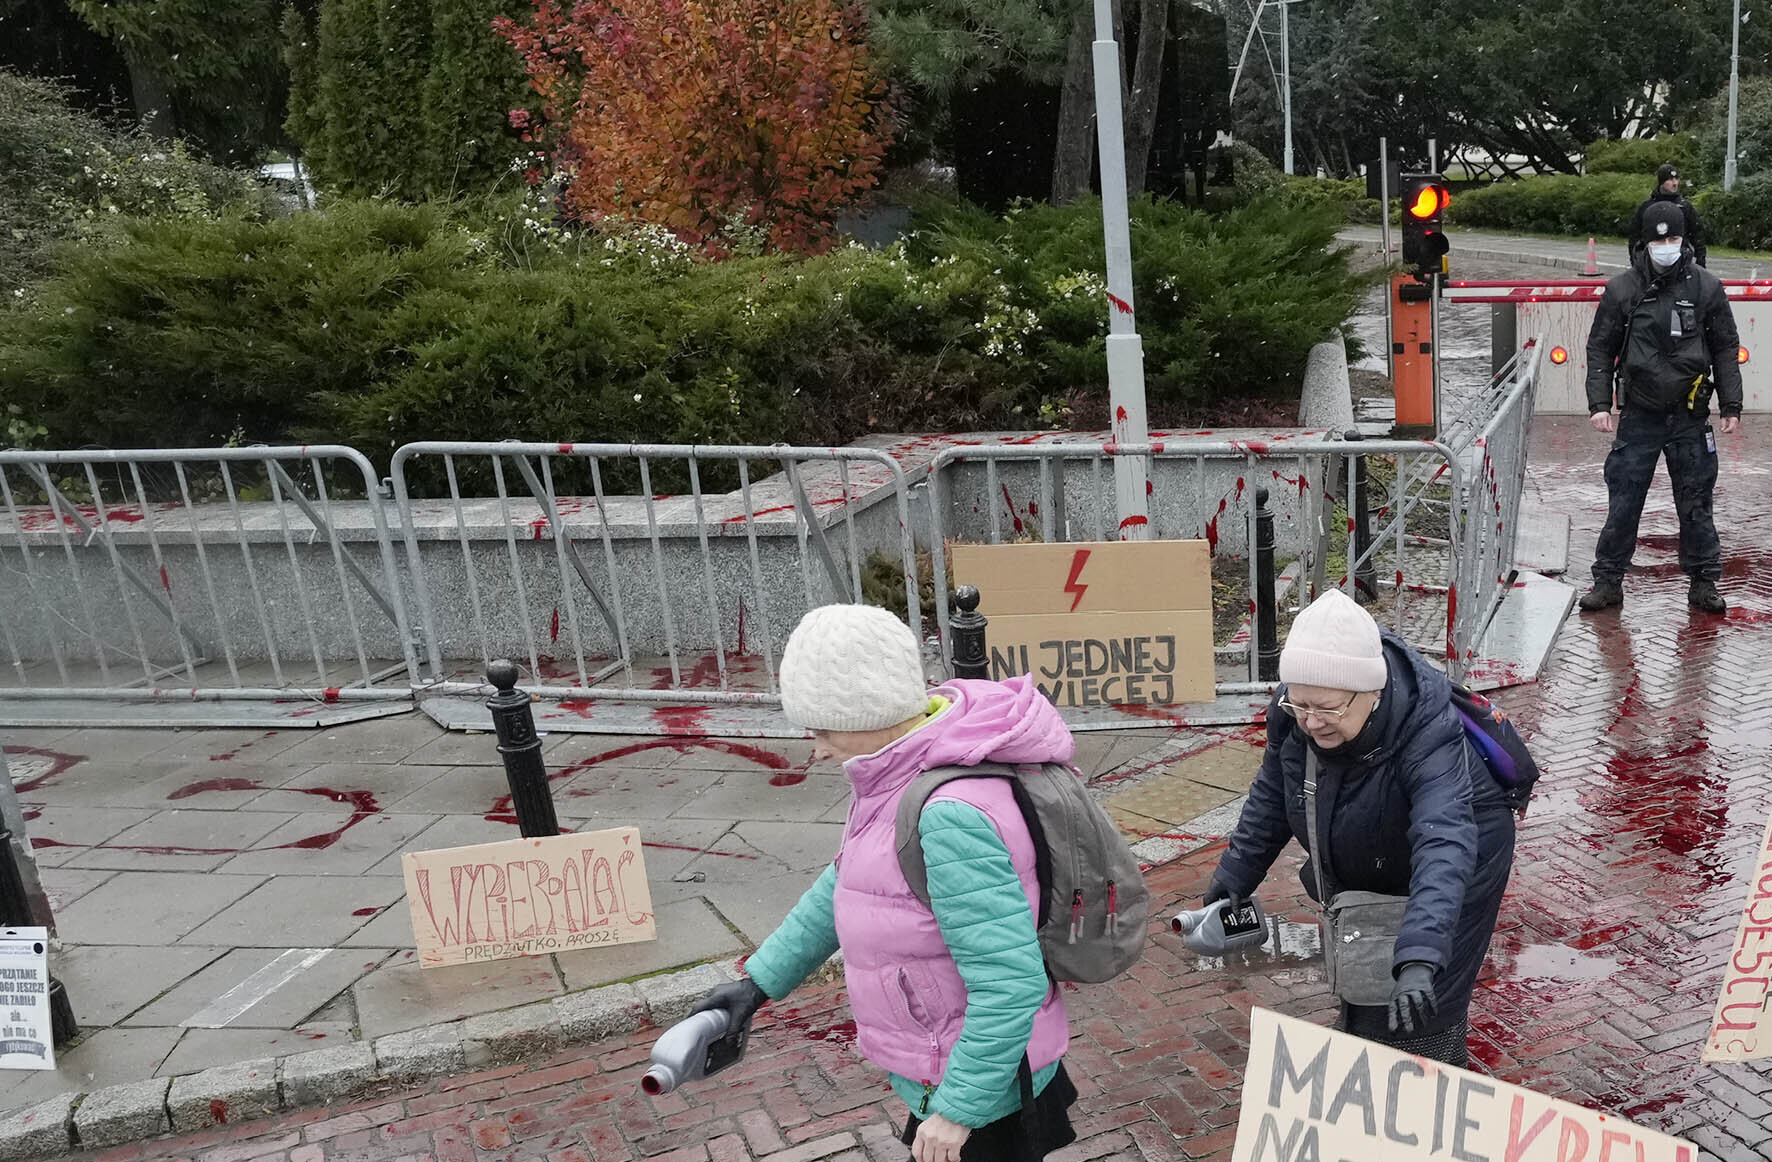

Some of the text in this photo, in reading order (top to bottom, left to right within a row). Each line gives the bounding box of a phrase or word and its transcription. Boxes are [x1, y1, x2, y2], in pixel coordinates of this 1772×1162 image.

[984, 634, 1176, 682] NI JEDNEJ
[16, 982, 45, 993] JESZCZE
